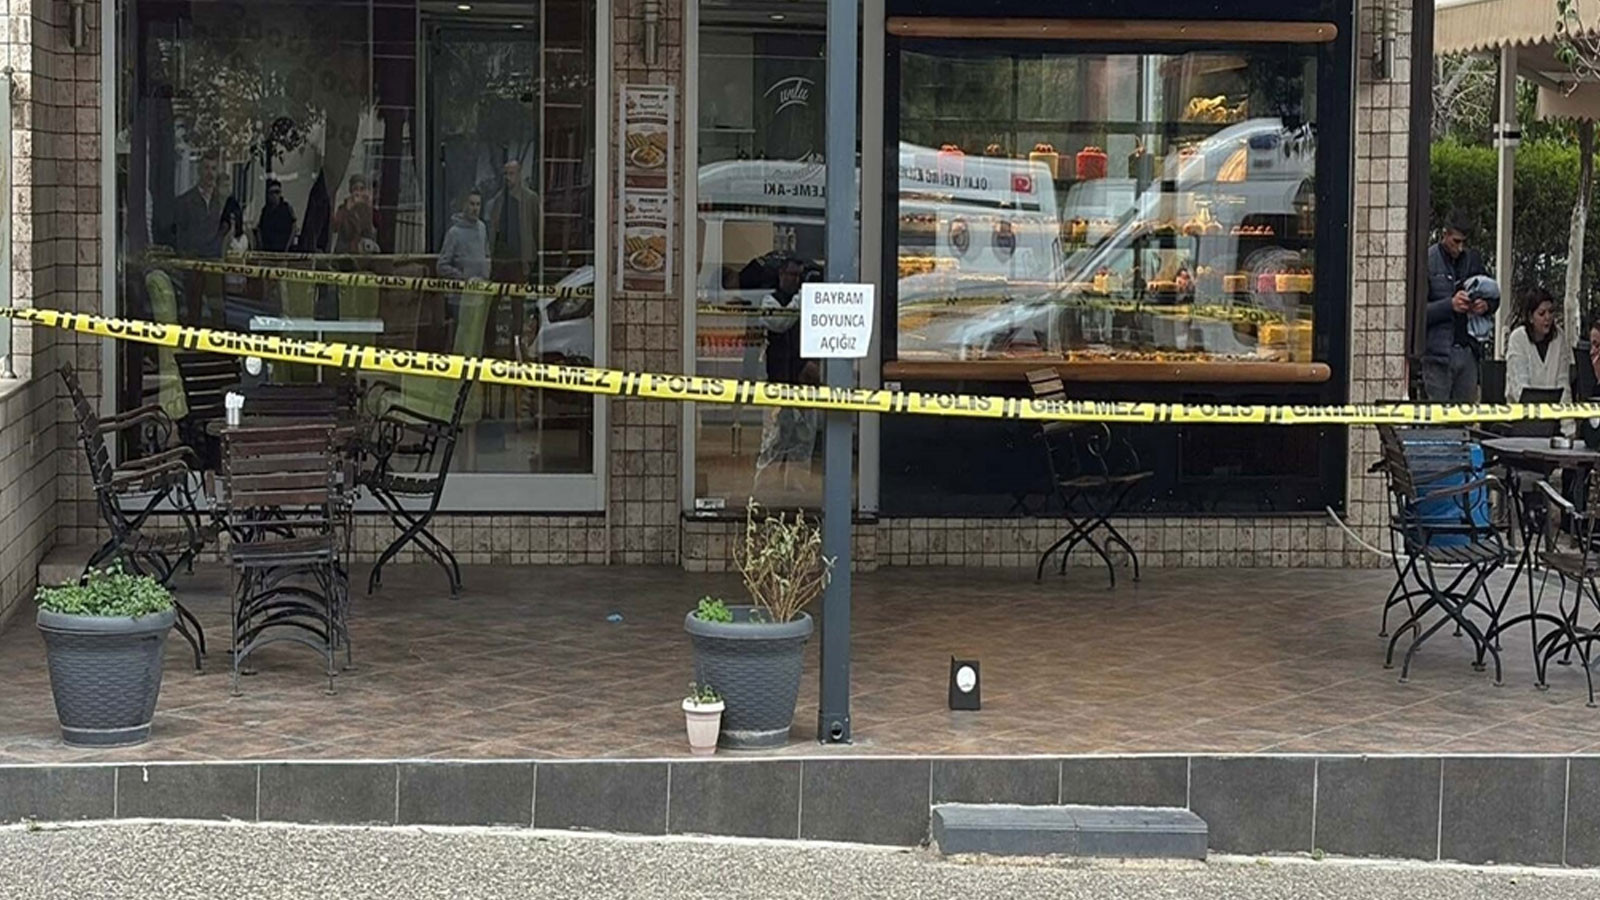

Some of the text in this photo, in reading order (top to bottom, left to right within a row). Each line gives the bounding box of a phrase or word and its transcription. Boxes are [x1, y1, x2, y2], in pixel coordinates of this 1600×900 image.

[814, 291, 864, 305] BAYRAM
[811, 313, 865, 328] BOYUNCA
[820, 333, 857, 353] AÇIĞIZ
